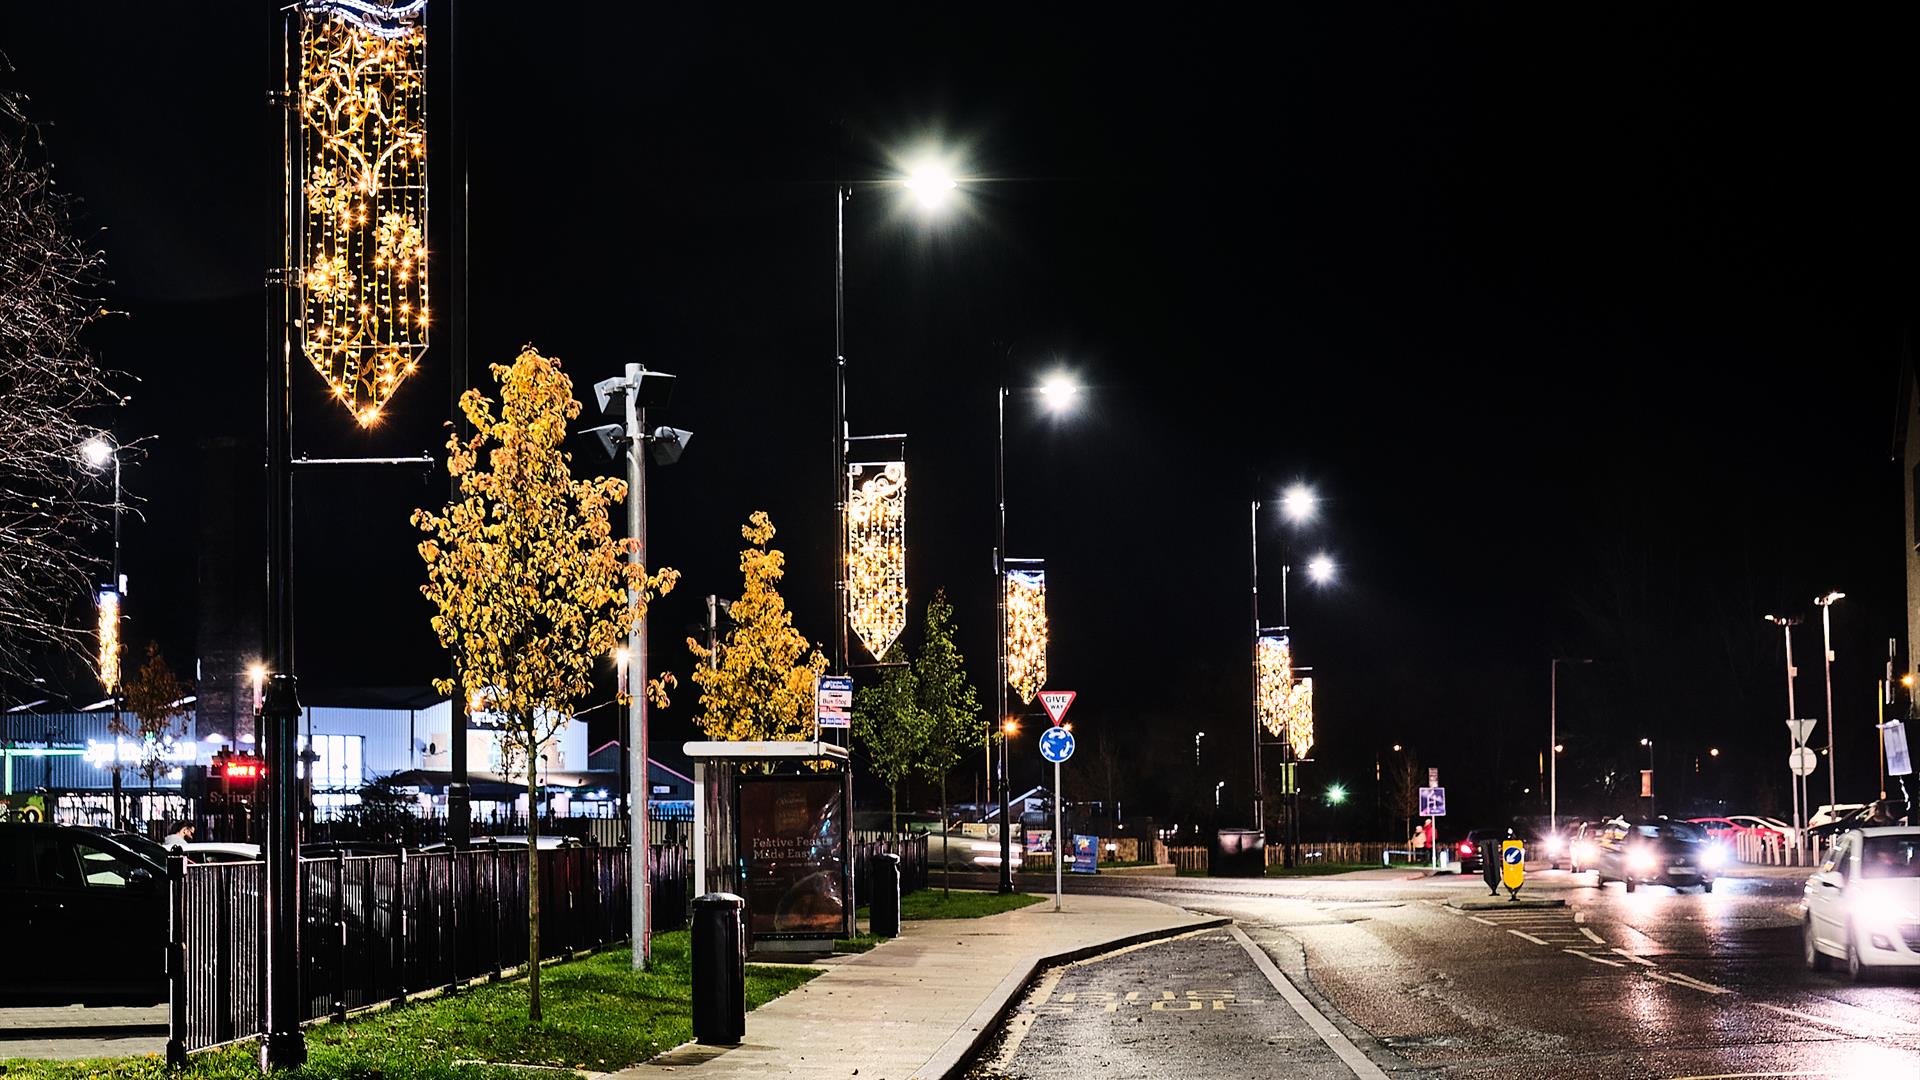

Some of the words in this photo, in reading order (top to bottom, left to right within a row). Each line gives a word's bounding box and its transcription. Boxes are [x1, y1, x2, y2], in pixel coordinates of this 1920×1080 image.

[1045, 695, 1067, 703] GIVE
[753, 837, 794, 848] Festive
[796, 836, 833, 848] Feasts
[753, 849, 785, 860] Made
